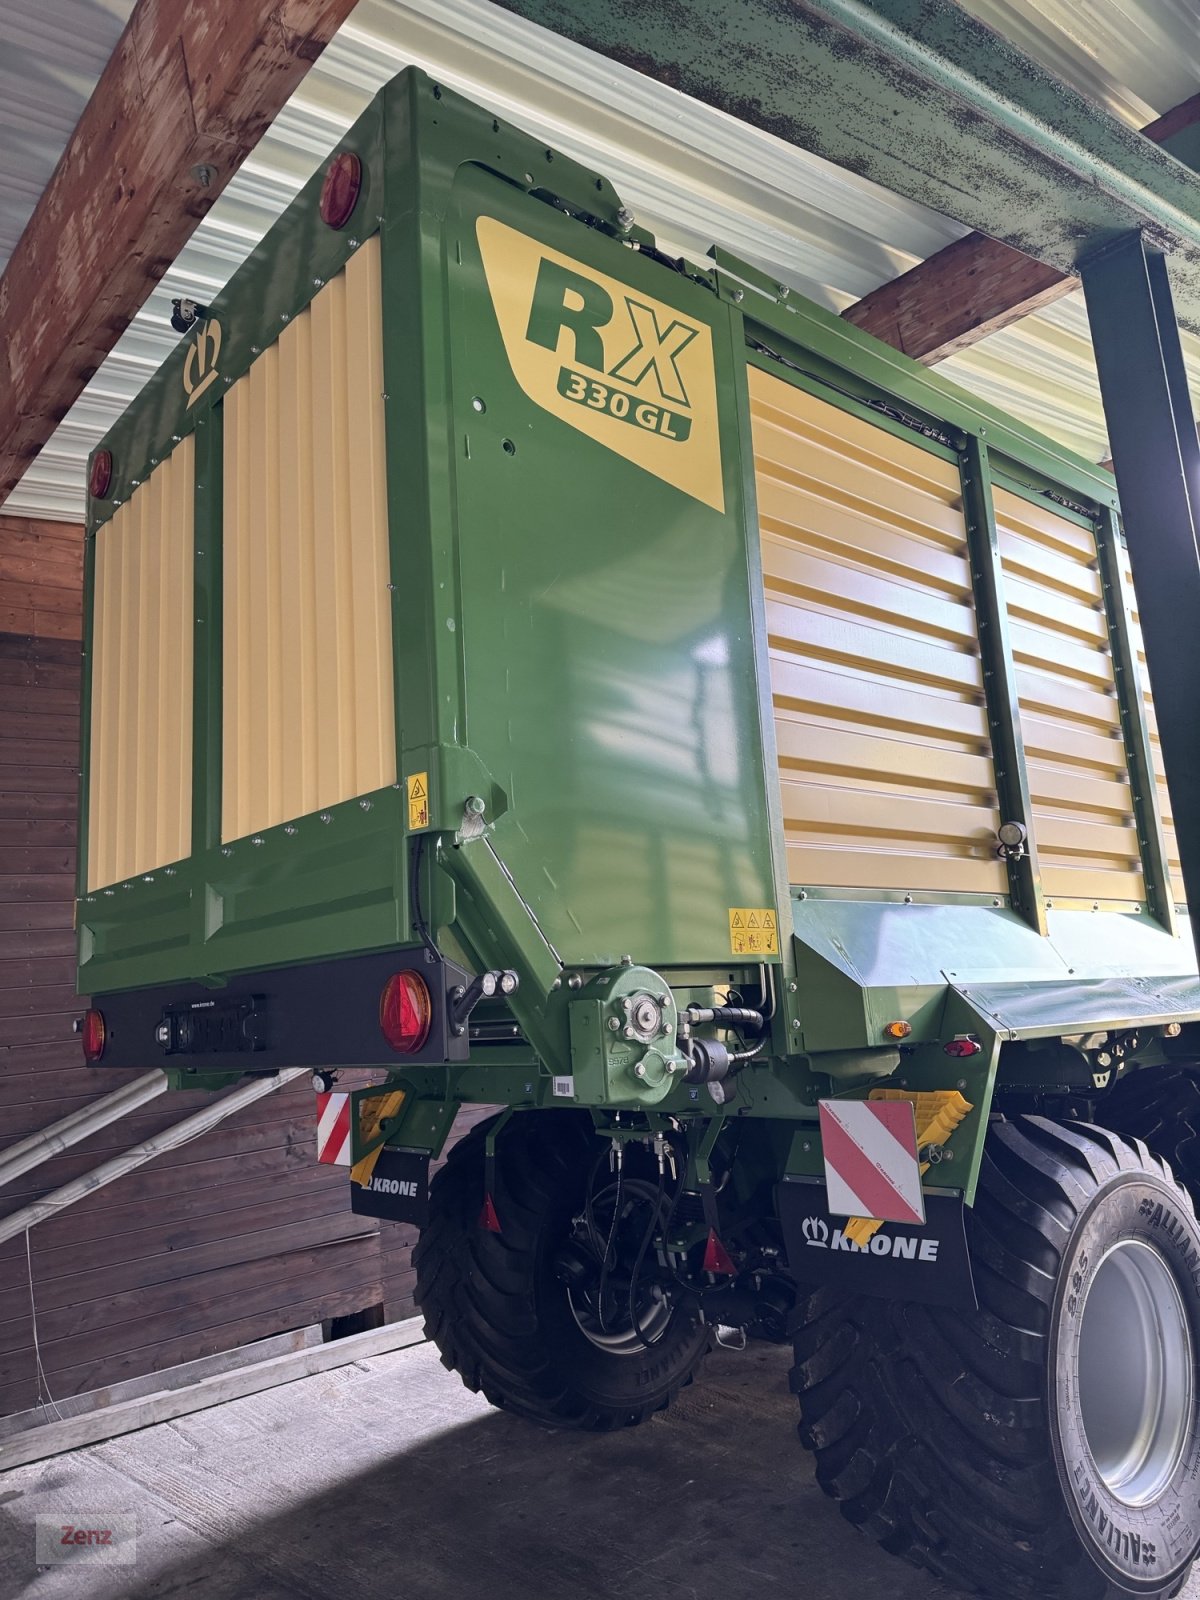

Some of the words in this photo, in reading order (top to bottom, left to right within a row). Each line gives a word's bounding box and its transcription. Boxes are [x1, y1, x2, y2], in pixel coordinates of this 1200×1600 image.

[525, 256, 700, 409] RX
[566, 374, 630, 418] 330
[635, 404, 677, 438] GL
[373, 1177, 418, 1197] KRONE
[1073, 1461, 1141, 1566] ALLIANCE
